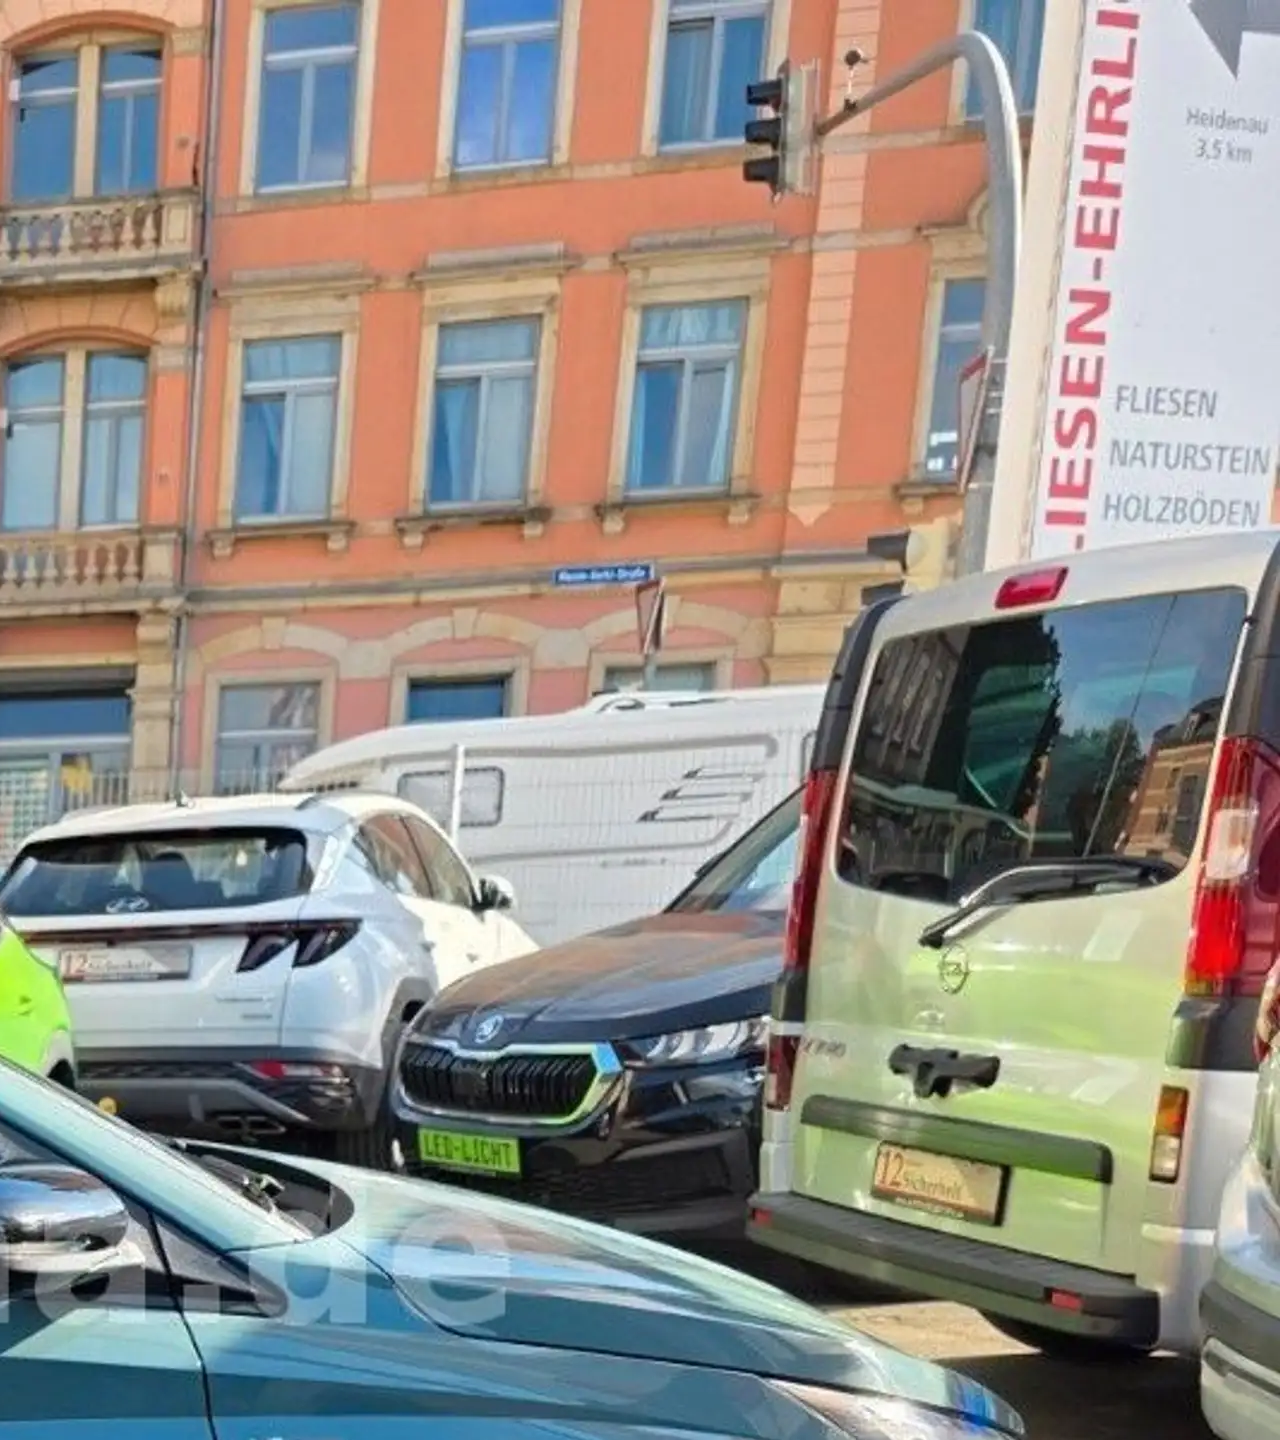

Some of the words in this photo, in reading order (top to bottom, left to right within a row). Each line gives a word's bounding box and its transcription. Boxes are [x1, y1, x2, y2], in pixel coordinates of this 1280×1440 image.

[1185, 107, 1270, 134] Heidenau
[1226, 139, 1253, 163] km
[1044, 0, 1140, 550] IESEN-EHRLI
[1115, 384, 1217, 418] FLIESEN
[1109, 438, 1271, 476] NATURSTEIN
[1103, 488, 1260, 528] HOLZBÖDEN
[423, 1132, 511, 1168] LED-LICHT
[878, 1151, 906, 1189] 12
